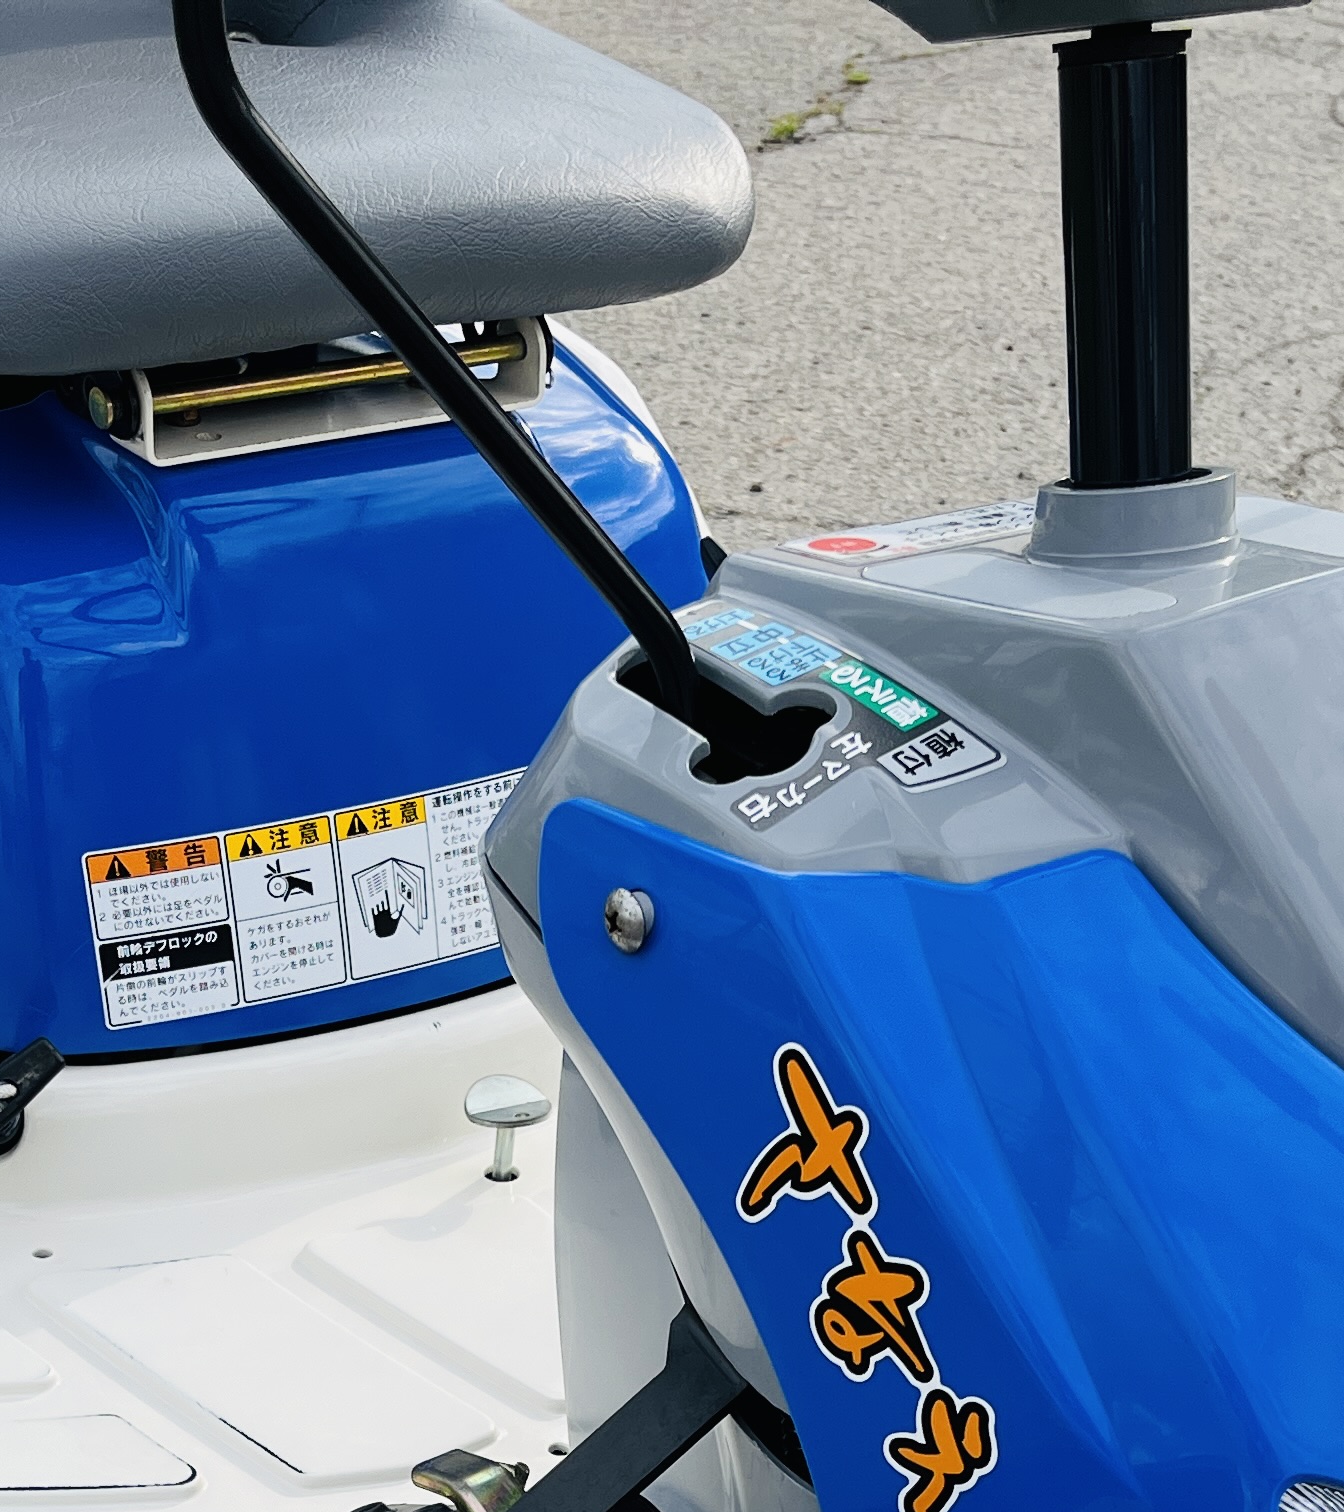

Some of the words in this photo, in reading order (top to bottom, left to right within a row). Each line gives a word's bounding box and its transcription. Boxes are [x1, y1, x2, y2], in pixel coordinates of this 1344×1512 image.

[719, 628, 783, 655] 中立
[830, 664, 928, 728] 植える
[891, 729, 965, 775] 植付
[372, 801, 419, 830] 注意
[269, 823, 320, 850] 注意
[145, 843, 206, 872] 警告
